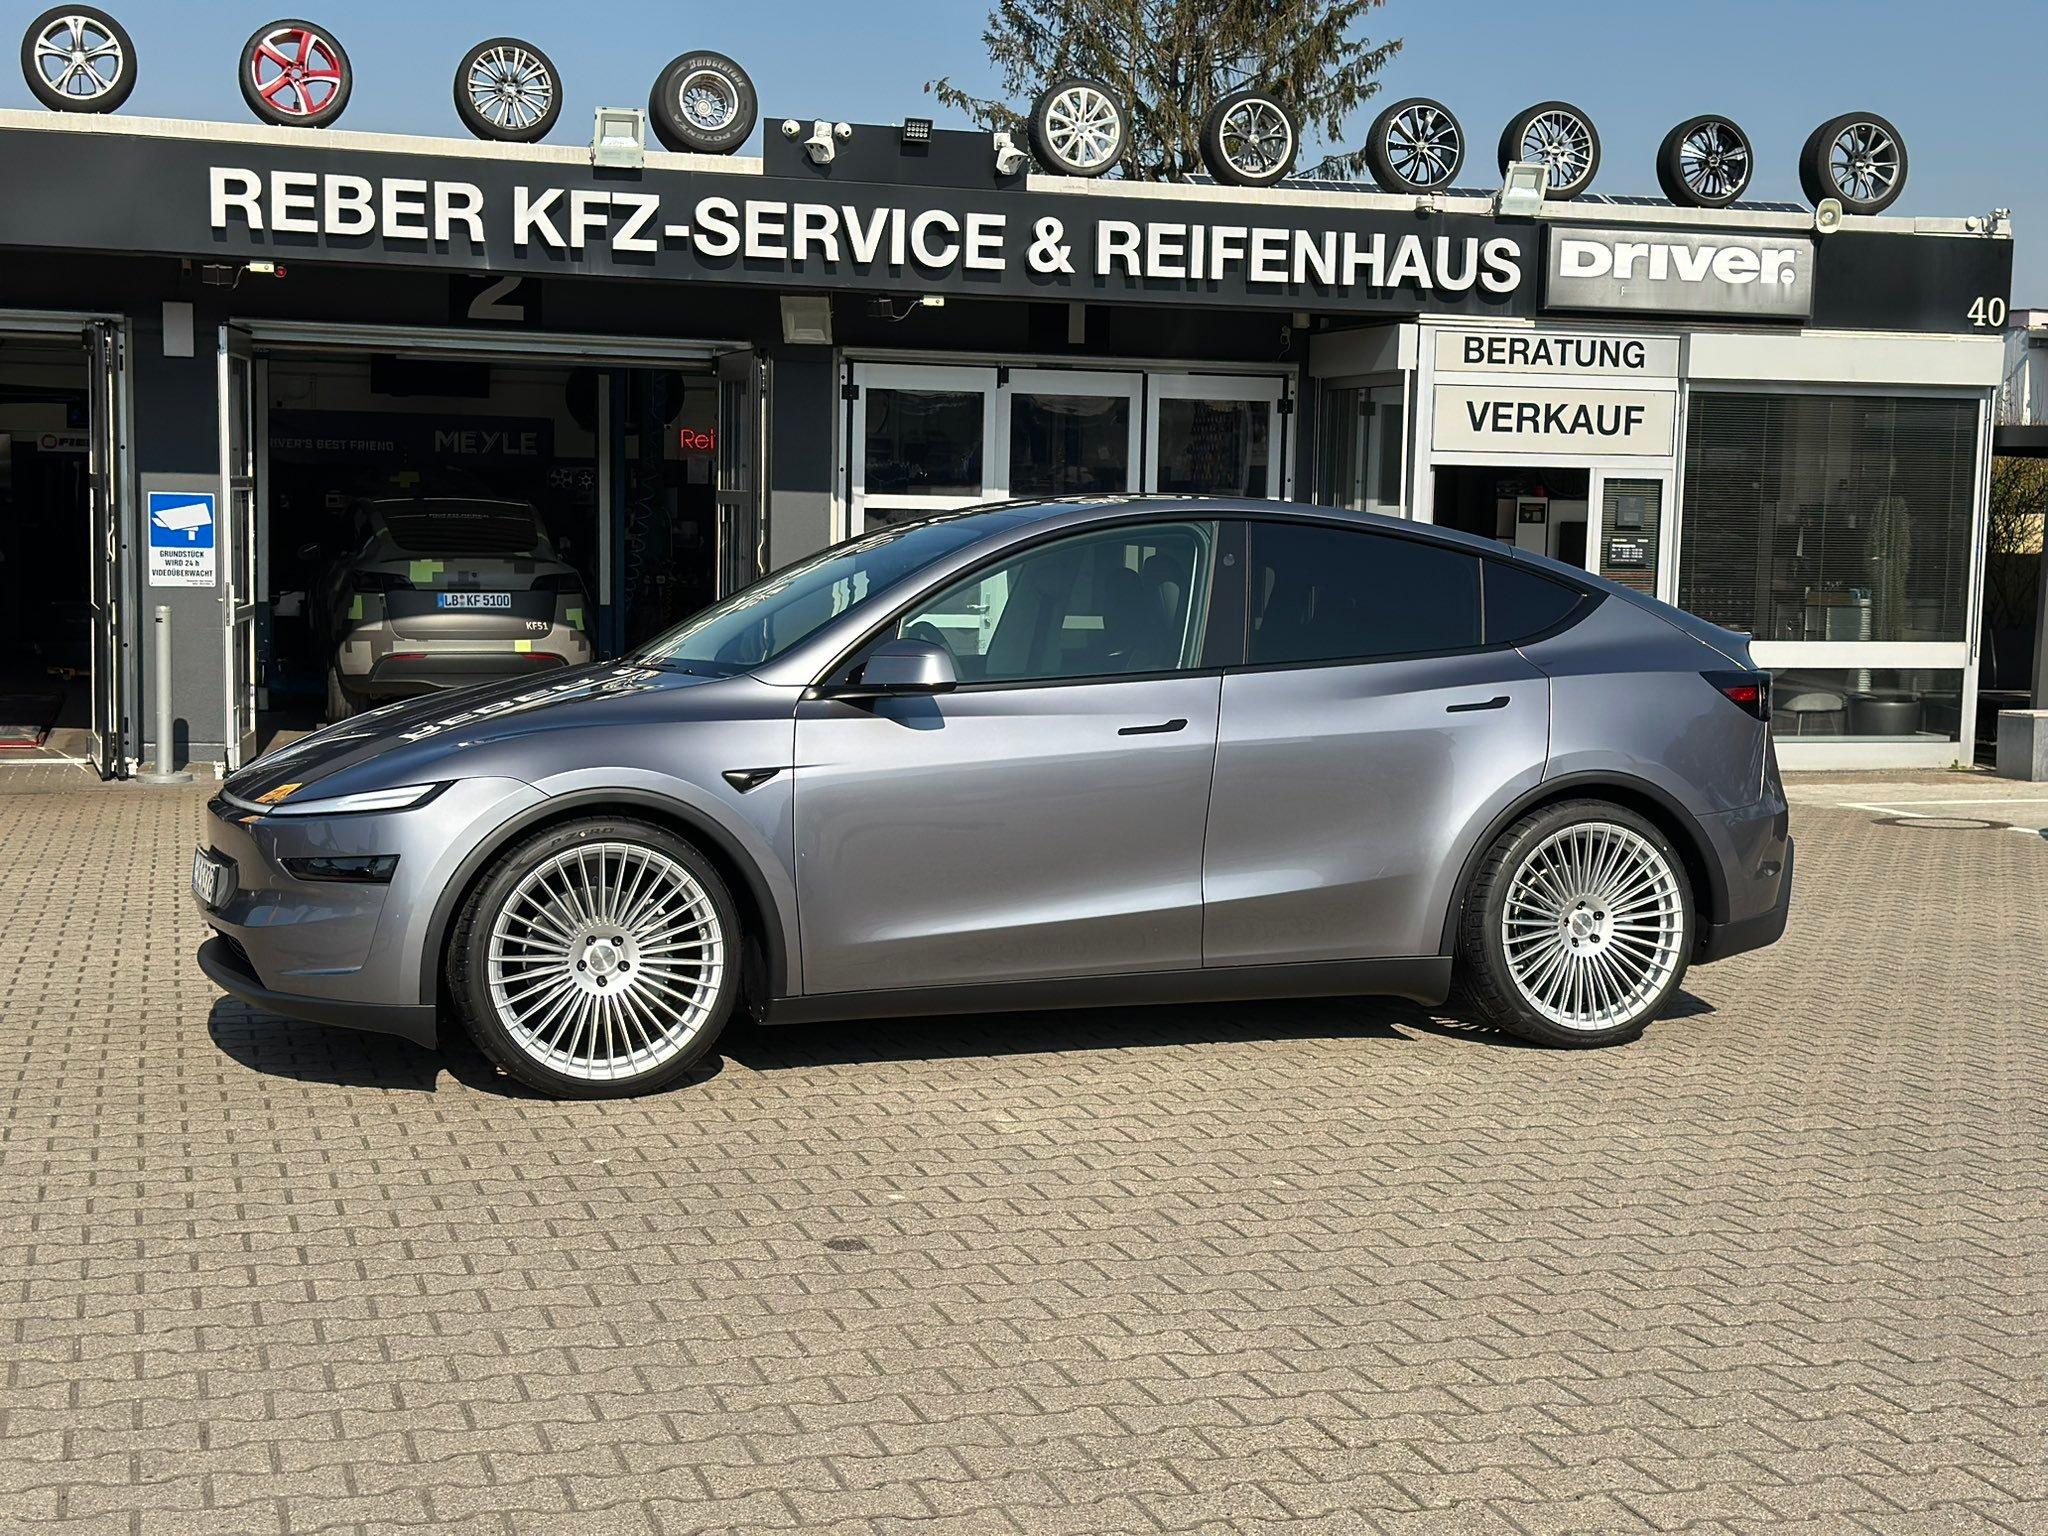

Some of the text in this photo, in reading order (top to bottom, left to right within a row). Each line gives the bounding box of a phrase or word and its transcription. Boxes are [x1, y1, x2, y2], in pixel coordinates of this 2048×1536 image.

[209, 166, 1521, 293] REBER KFZ-SERVICE & REIFENHAUS
[467, 275, 524, 320] 2
[1966, 296, 2006, 327] 40
[1463, 336, 1645, 369] BERATUNG
[1466, 400, 1645, 436] VERKAUF
[316, 439, 347, 450] BEST
[350, 439, 394, 452] FRIEND
[434, 429, 538, 456] MEYLE
[680, 428, 714, 449] Rei
[160, 549, 205, 558] GRUNDSTÜCK
[165, 559, 184, 567] WIRD
[185, 559, 194, 567] 24
[152, 568, 213, 577] VIDEOÜBERWACHT
[444, 594, 510, 607] LB KF 5100
[525, 621, 549, 631] KF51
